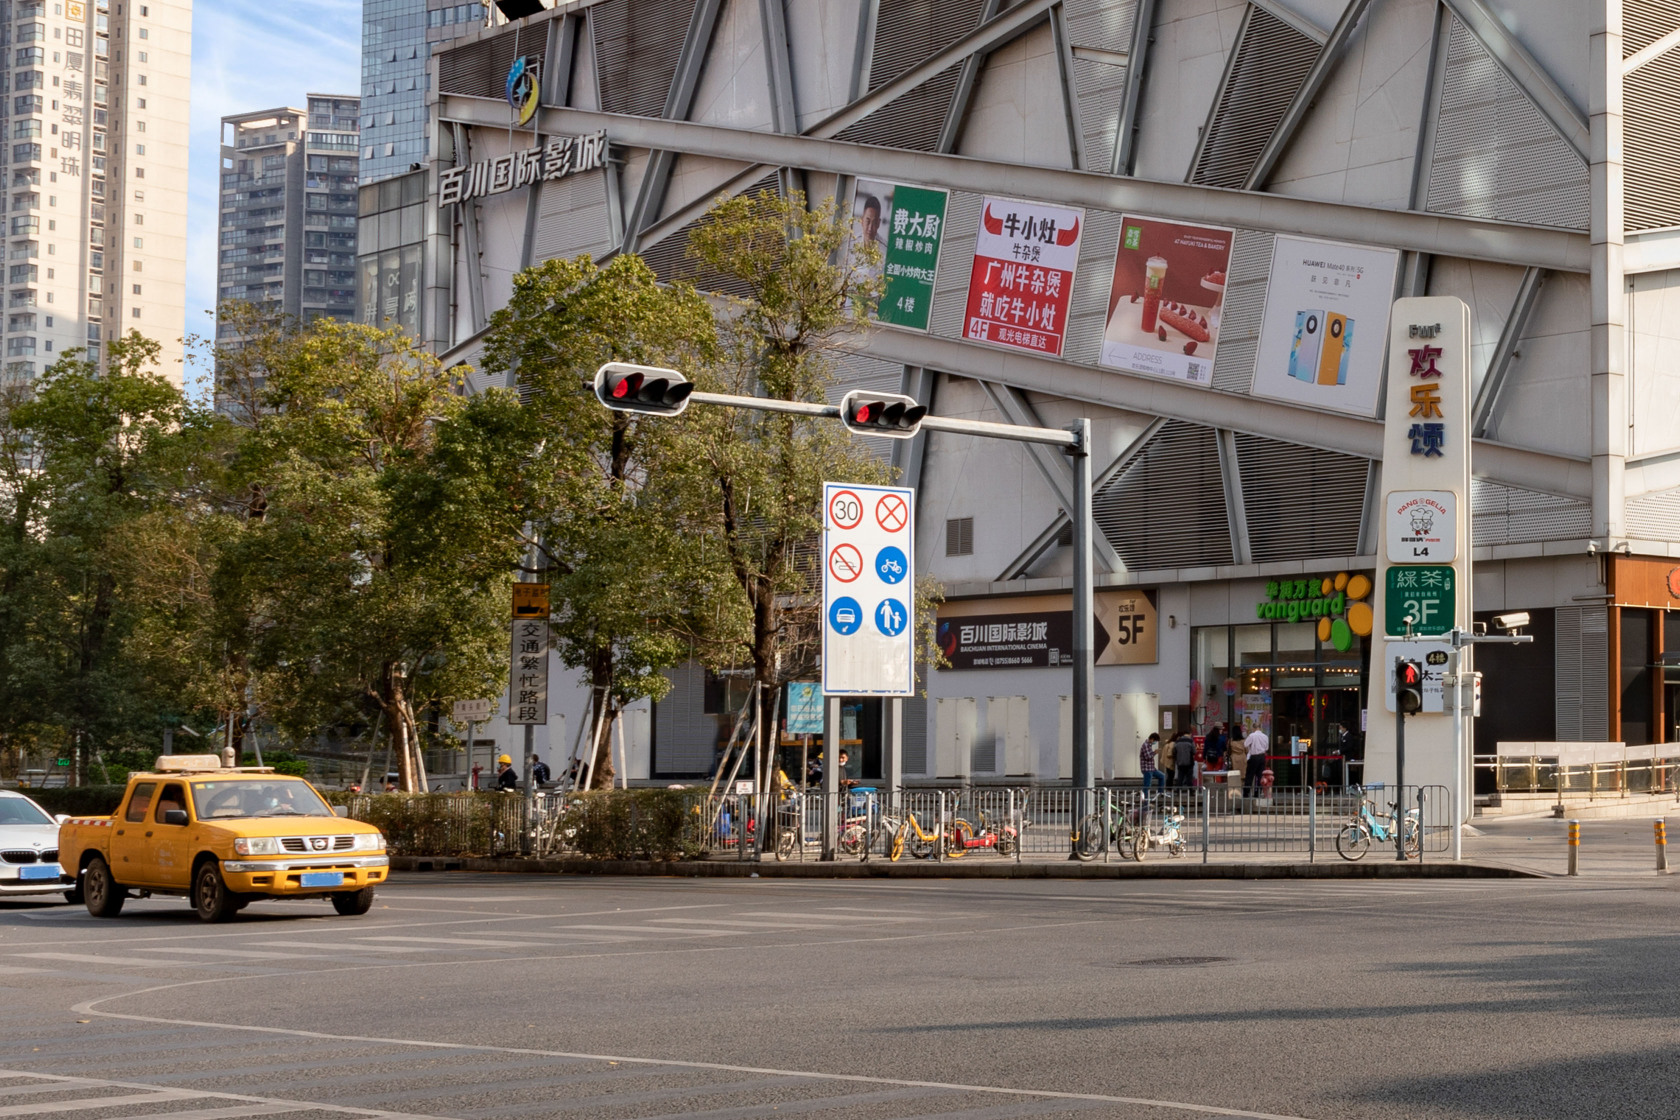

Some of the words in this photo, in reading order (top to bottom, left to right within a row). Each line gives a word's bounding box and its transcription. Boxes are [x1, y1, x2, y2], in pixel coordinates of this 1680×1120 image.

[438, 129, 608, 208] 百川国际影城
[893, 208, 941, 240] 费大厨
[1004, 213, 1057, 245] 牛小灶
[894, 236, 934, 255] 辣椒炒肉
[1012, 243, 1041, 262] 牛杂煲
[886, 262, 935, 282] 全国小炒肉大王
[1302, 259, 1326, 269] HUAWEI
[983, 260, 1062, 298] 广州牛杂煲
[896, 296, 916, 313] 4楼
[979, 291, 1057, 331] 就吃牛小灶
[970, 317, 988, 339] 4F
[997, 327, 1047, 349] 观光电梯直达
[1133, 352, 1163, 365] ADDRESS
[1408, 344, 1445, 458] 欢乐颂
[835, 500, 859, 521] 30
[1413, 547, 1430, 557] L4
[1264, 578, 1323, 601] 华润万家
[1256, 592, 1346, 623] vanguard
[1403, 599, 1440, 625] 3F
[960, 621, 1048, 644] 百川国际影城
[1118, 614, 1146, 645] 5F
[960, 645, 987, 653] BAICHUAN
[987, 643, 1027, 652] INTERNATIONAL
[1027, 642, 1048, 650] CINEMA
[517, 622, 541, 722] 交通繁忙路段
